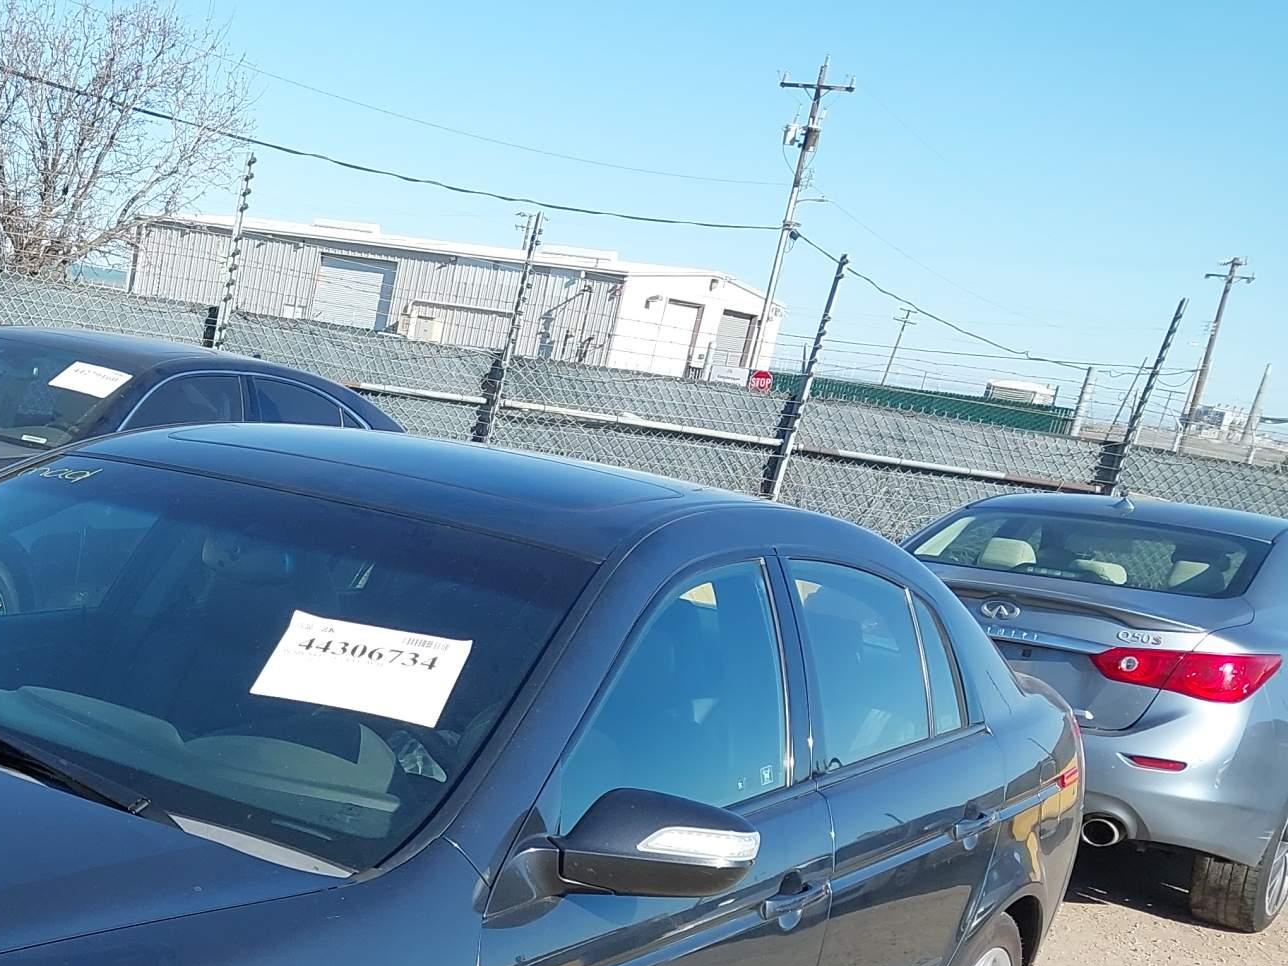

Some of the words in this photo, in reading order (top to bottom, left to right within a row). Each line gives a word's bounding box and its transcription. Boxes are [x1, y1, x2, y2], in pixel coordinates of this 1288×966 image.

[751, 377, 771, 389] STOP
[1116, 631, 1163, 646] Q50S
[298, 637, 439, 671] 44306734
